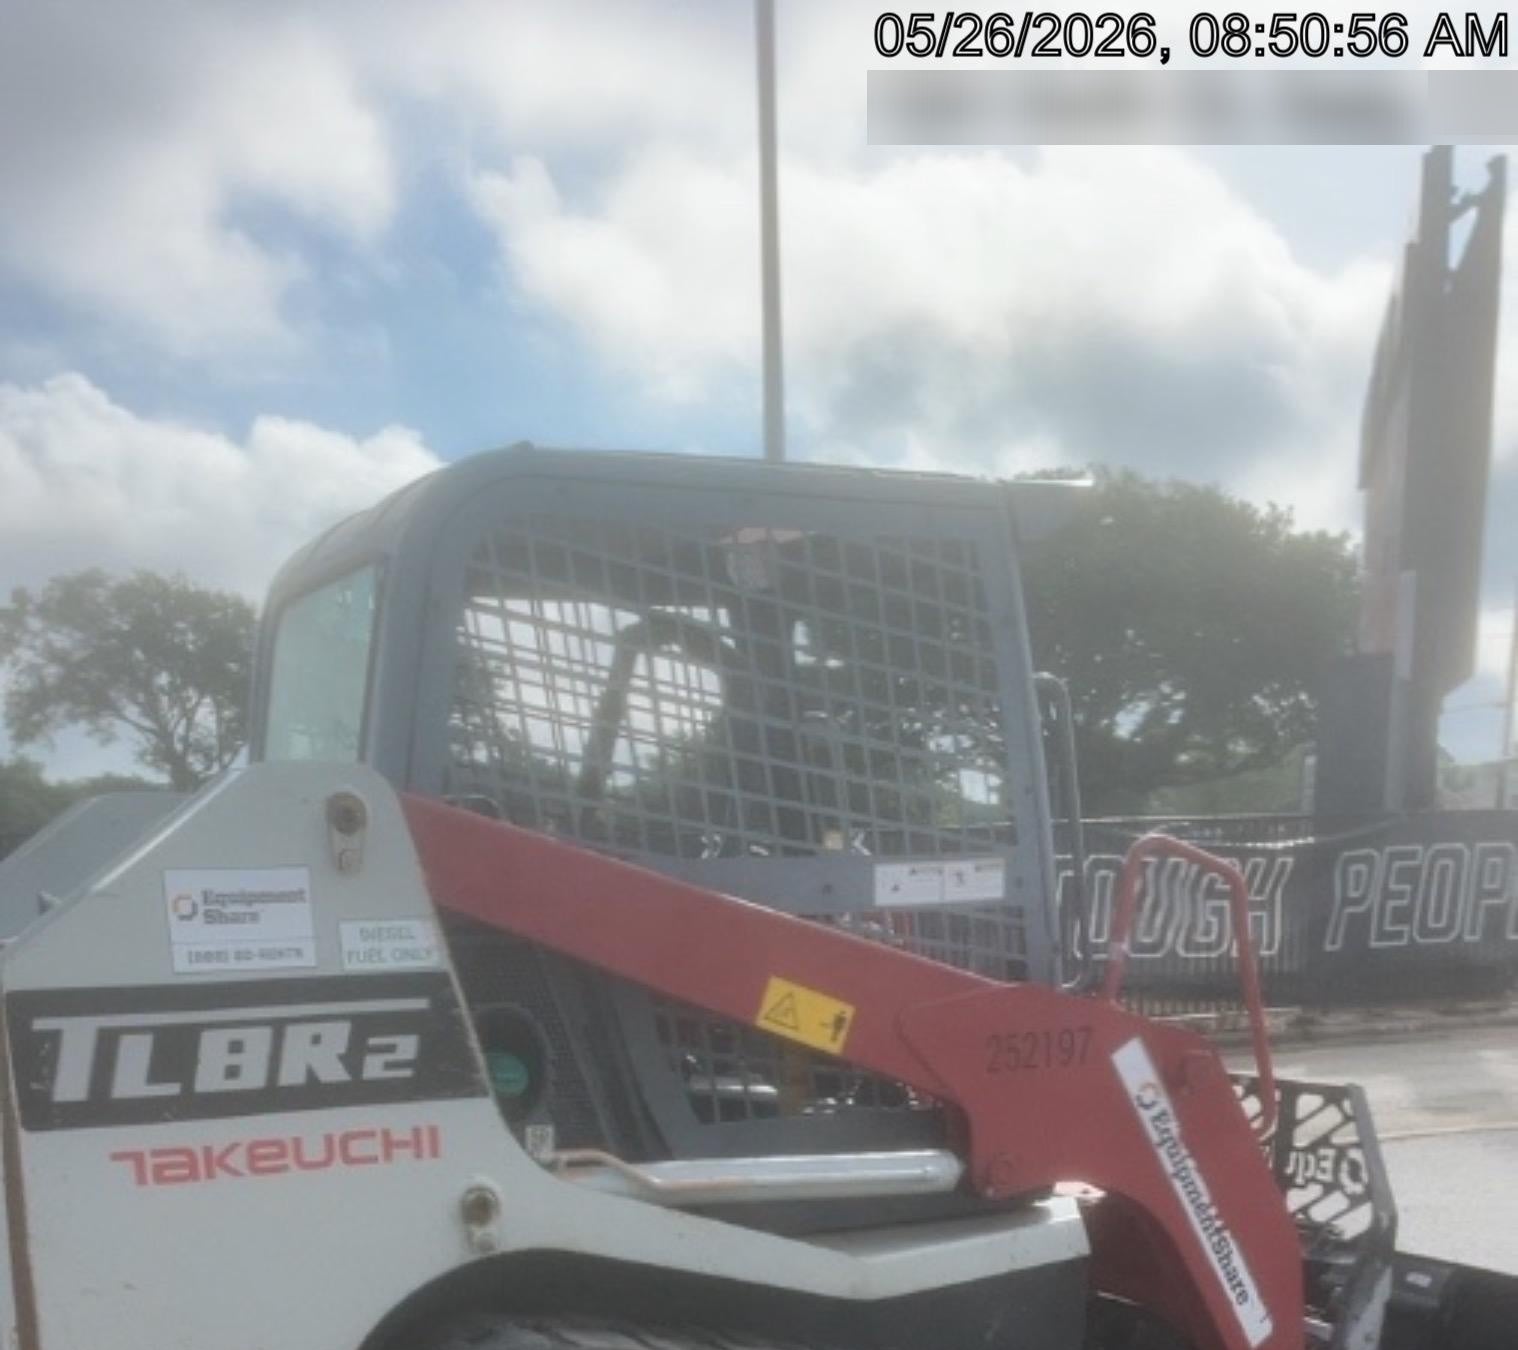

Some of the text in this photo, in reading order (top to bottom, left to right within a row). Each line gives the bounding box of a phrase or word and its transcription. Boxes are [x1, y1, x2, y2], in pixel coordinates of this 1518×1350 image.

[201, 888, 306, 909] Equipment
[203, 908, 260, 925] Share
[1325, 841, 1518, 951] PEOP
[346, 946, 434, 964] FUEL ONLY
[985, 1025, 1093, 1074] 252197
[110, 1125, 441, 1187] TAKEUCHI
[1150, 1110, 1250, 1306] EquipmentShare
